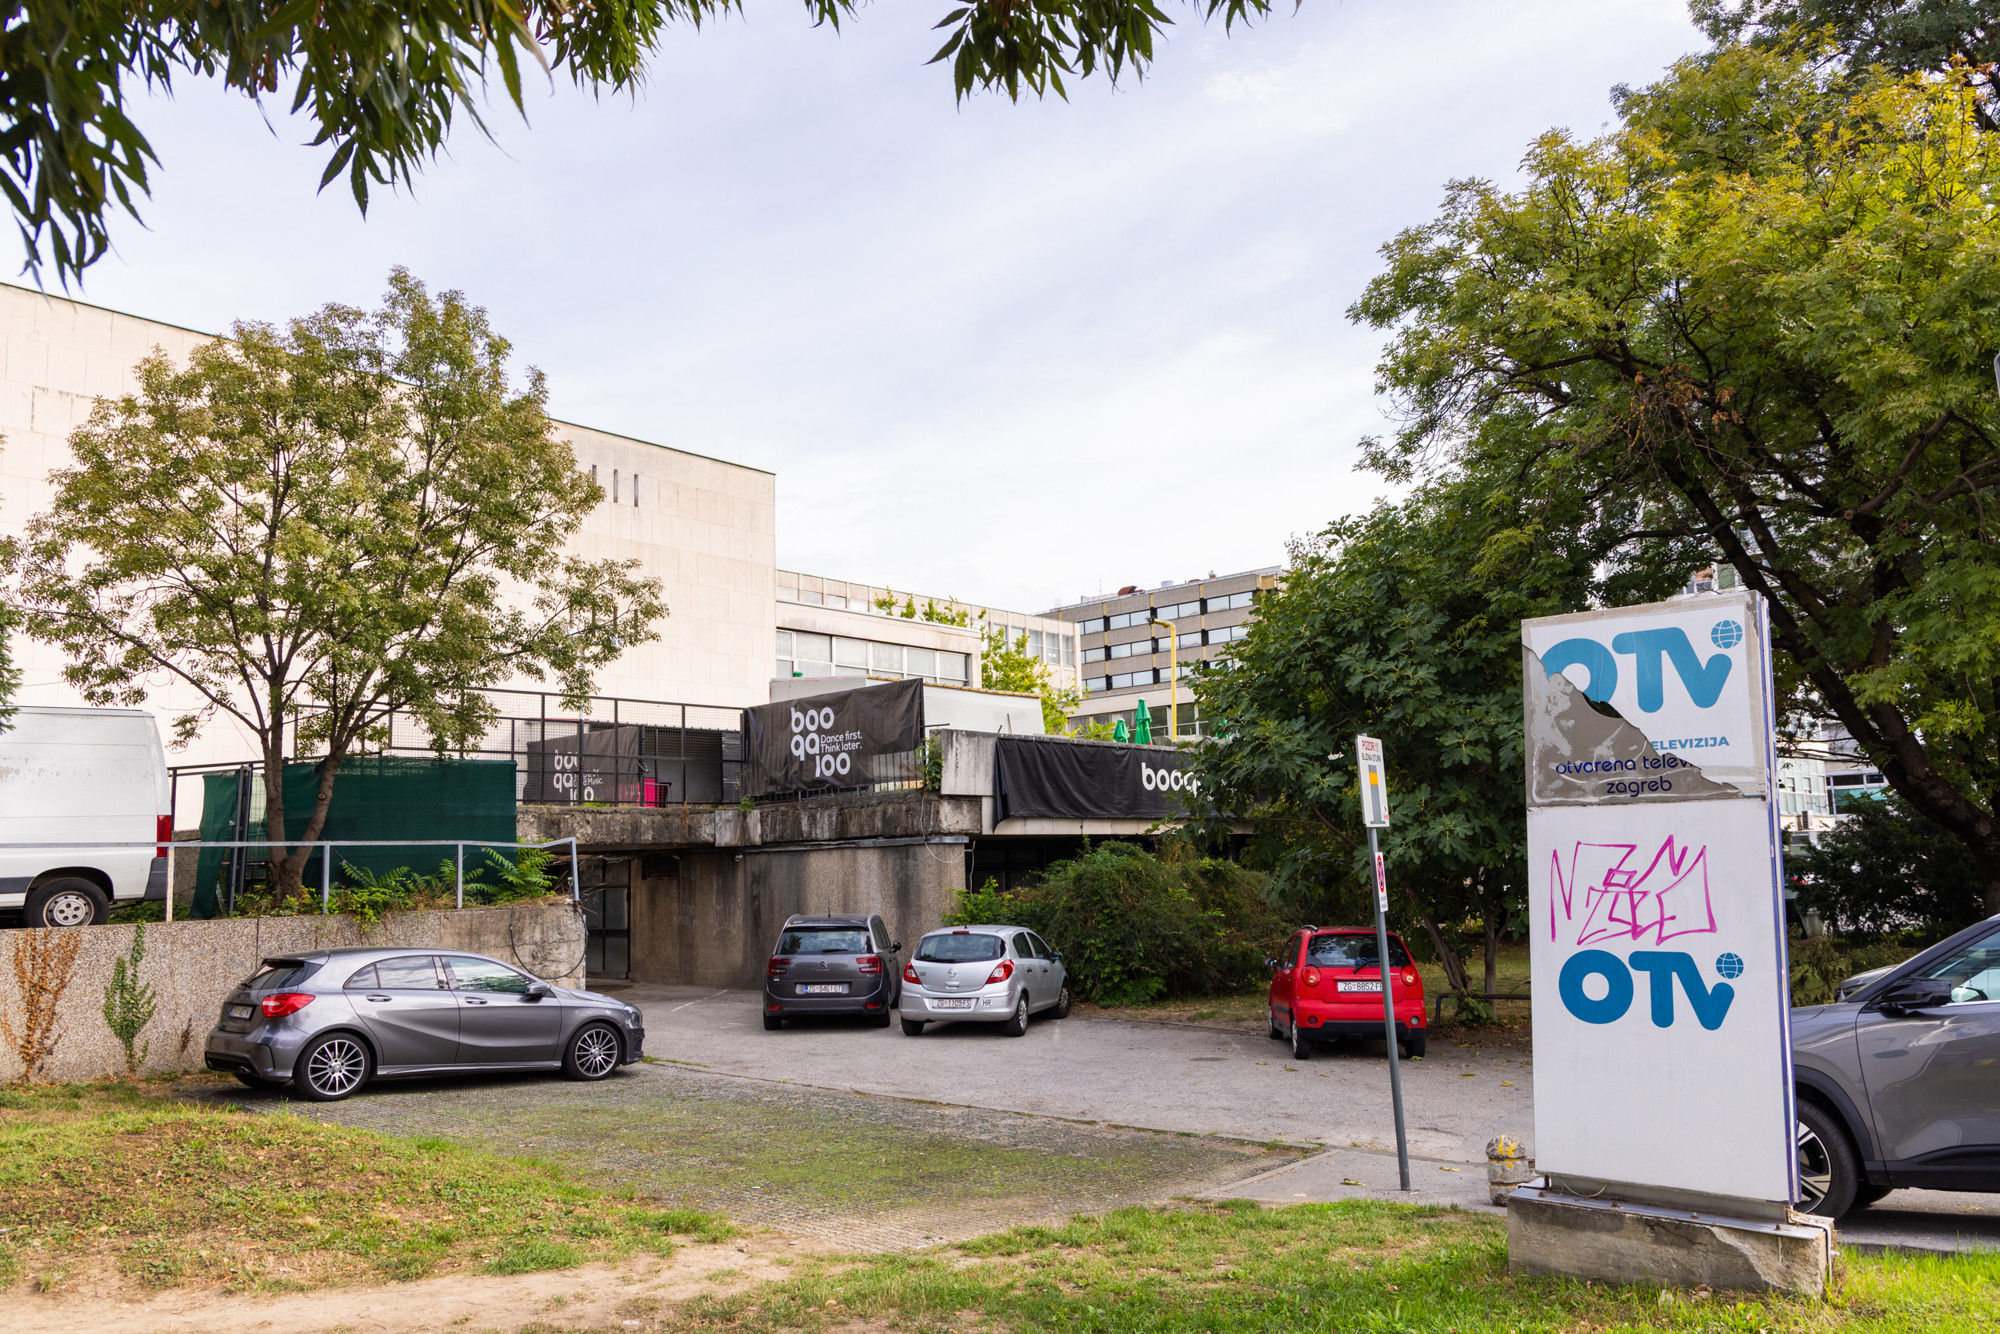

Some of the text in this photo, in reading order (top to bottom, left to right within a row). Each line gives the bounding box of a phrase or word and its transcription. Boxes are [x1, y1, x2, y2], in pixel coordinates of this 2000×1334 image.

[1540, 626, 1733, 713] OTV
[791, 707, 834, 733] boo
[821, 731, 863, 744] Dance first.
[1650, 736, 1731, 751] ELEVIZIJA
[821, 742, 863, 754] Think later.
[1556, 754, 1694, 775] otvorena telev
[1606, 776, 1672, 798] zagreb
[1343, 982, 1352, 991] ZG
[1558, 949, 1735, 1031] OTV
[936, 999, 945, 1007] ZG
[982, 999, 992, 1007] HR
